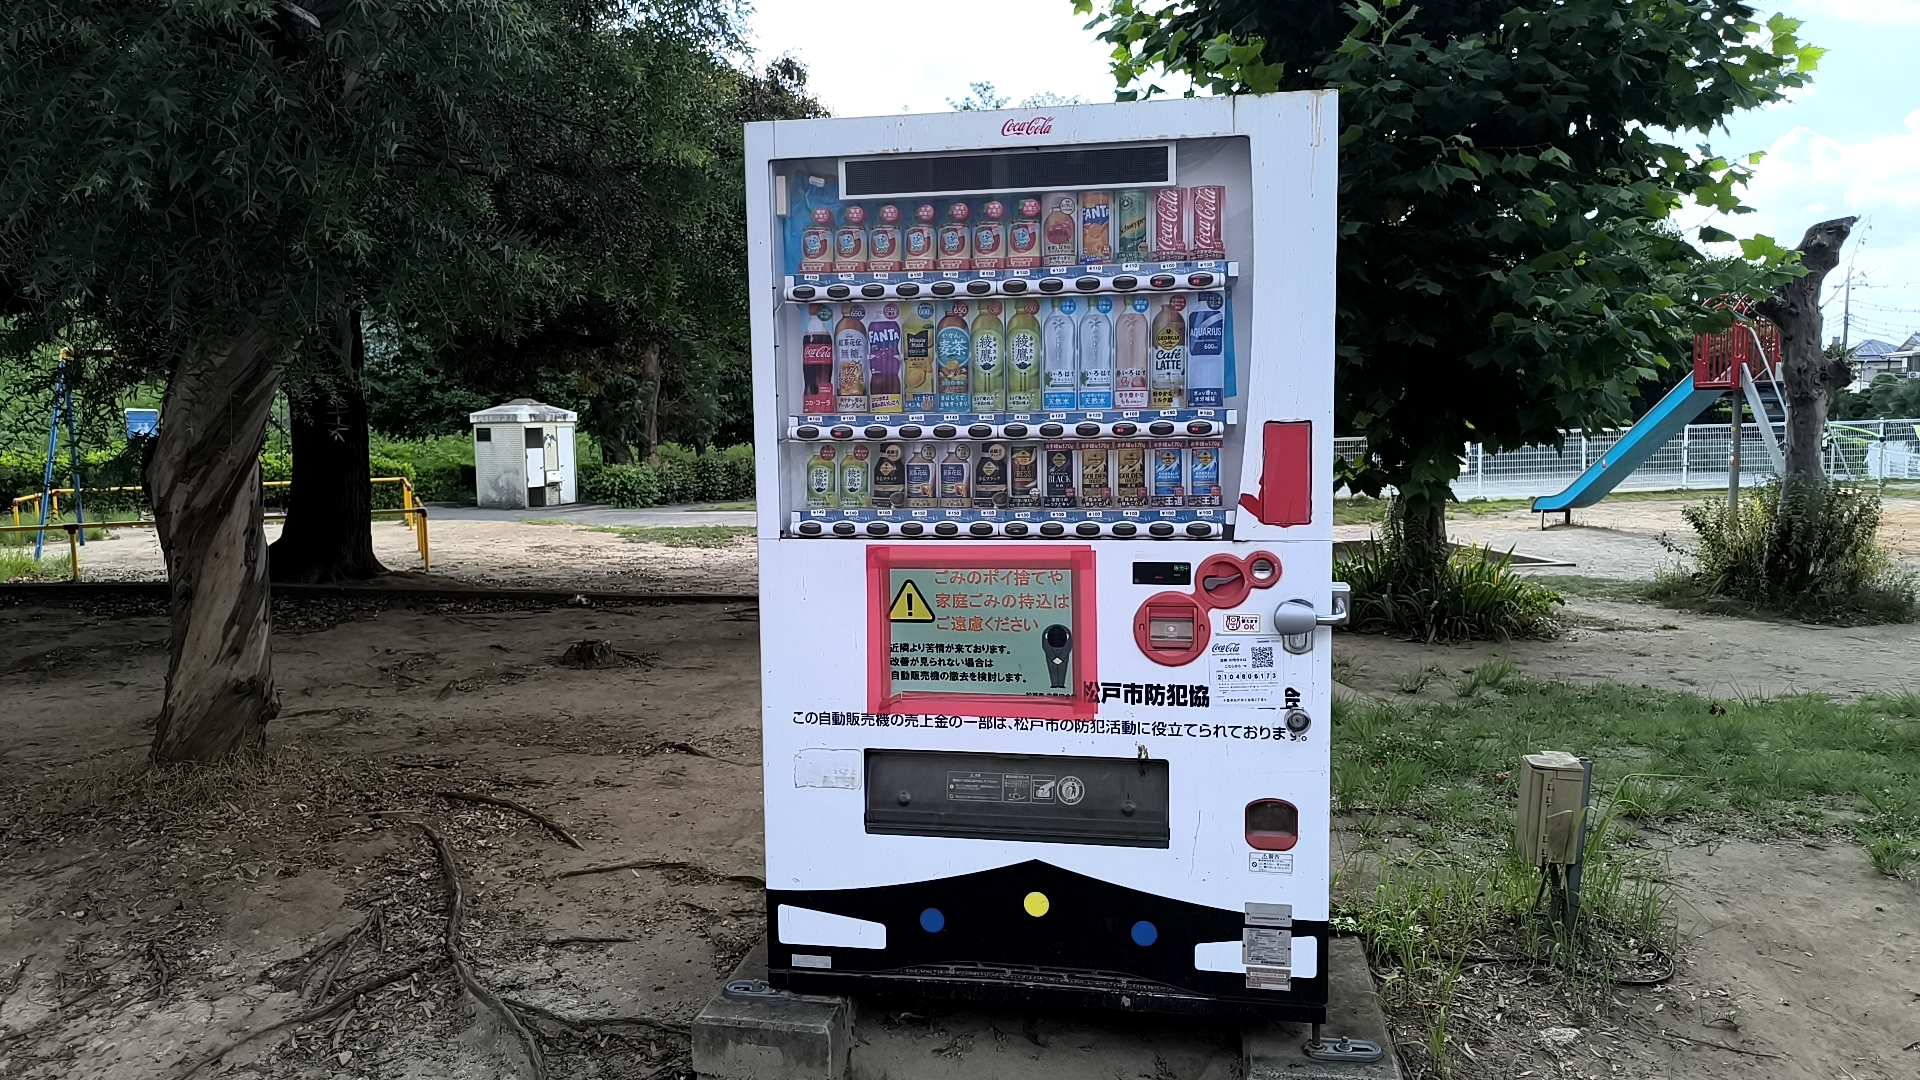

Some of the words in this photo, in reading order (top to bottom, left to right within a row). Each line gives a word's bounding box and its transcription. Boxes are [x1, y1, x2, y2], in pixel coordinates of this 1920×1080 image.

[1001, 116, 1055, 137] Coca-Cola
[1157, 189, 1178, 250] Coca-Cola
[1195, 187, 1216, 249] Coca-Cola
[869, 329, 900, 343] FANTA
[1190, 328, 1222, 337] AQUARIUS
[804, 346, 831, 358] Coca-Cola
[841, 349, 860, 358] 無糖
[938, 339, 968, 356] 麦茶
[979, 335, 993, 362] 綾鷹
[1015, 334, 1029, 362] 綾鷹
[1156, 349, 1181, 360] Café
[1156, 360, 1181, 370] LATTE
[1048, 475, 1071, 483] BLACK
[935, 569, 1063, 586] ごみのポイ捨てや
[936, 593, 1070, 609] 家庭ごみの持込は
[936, 615, 1039, 632] ご遠慮ください
[890, 643, 1011, 655] 近隣より苦情が来ております。
[890, 657, 994, 668] 改善が見られない場合は
[891, 671, 1027, 683] 自動販売機の撤去を検討します。
